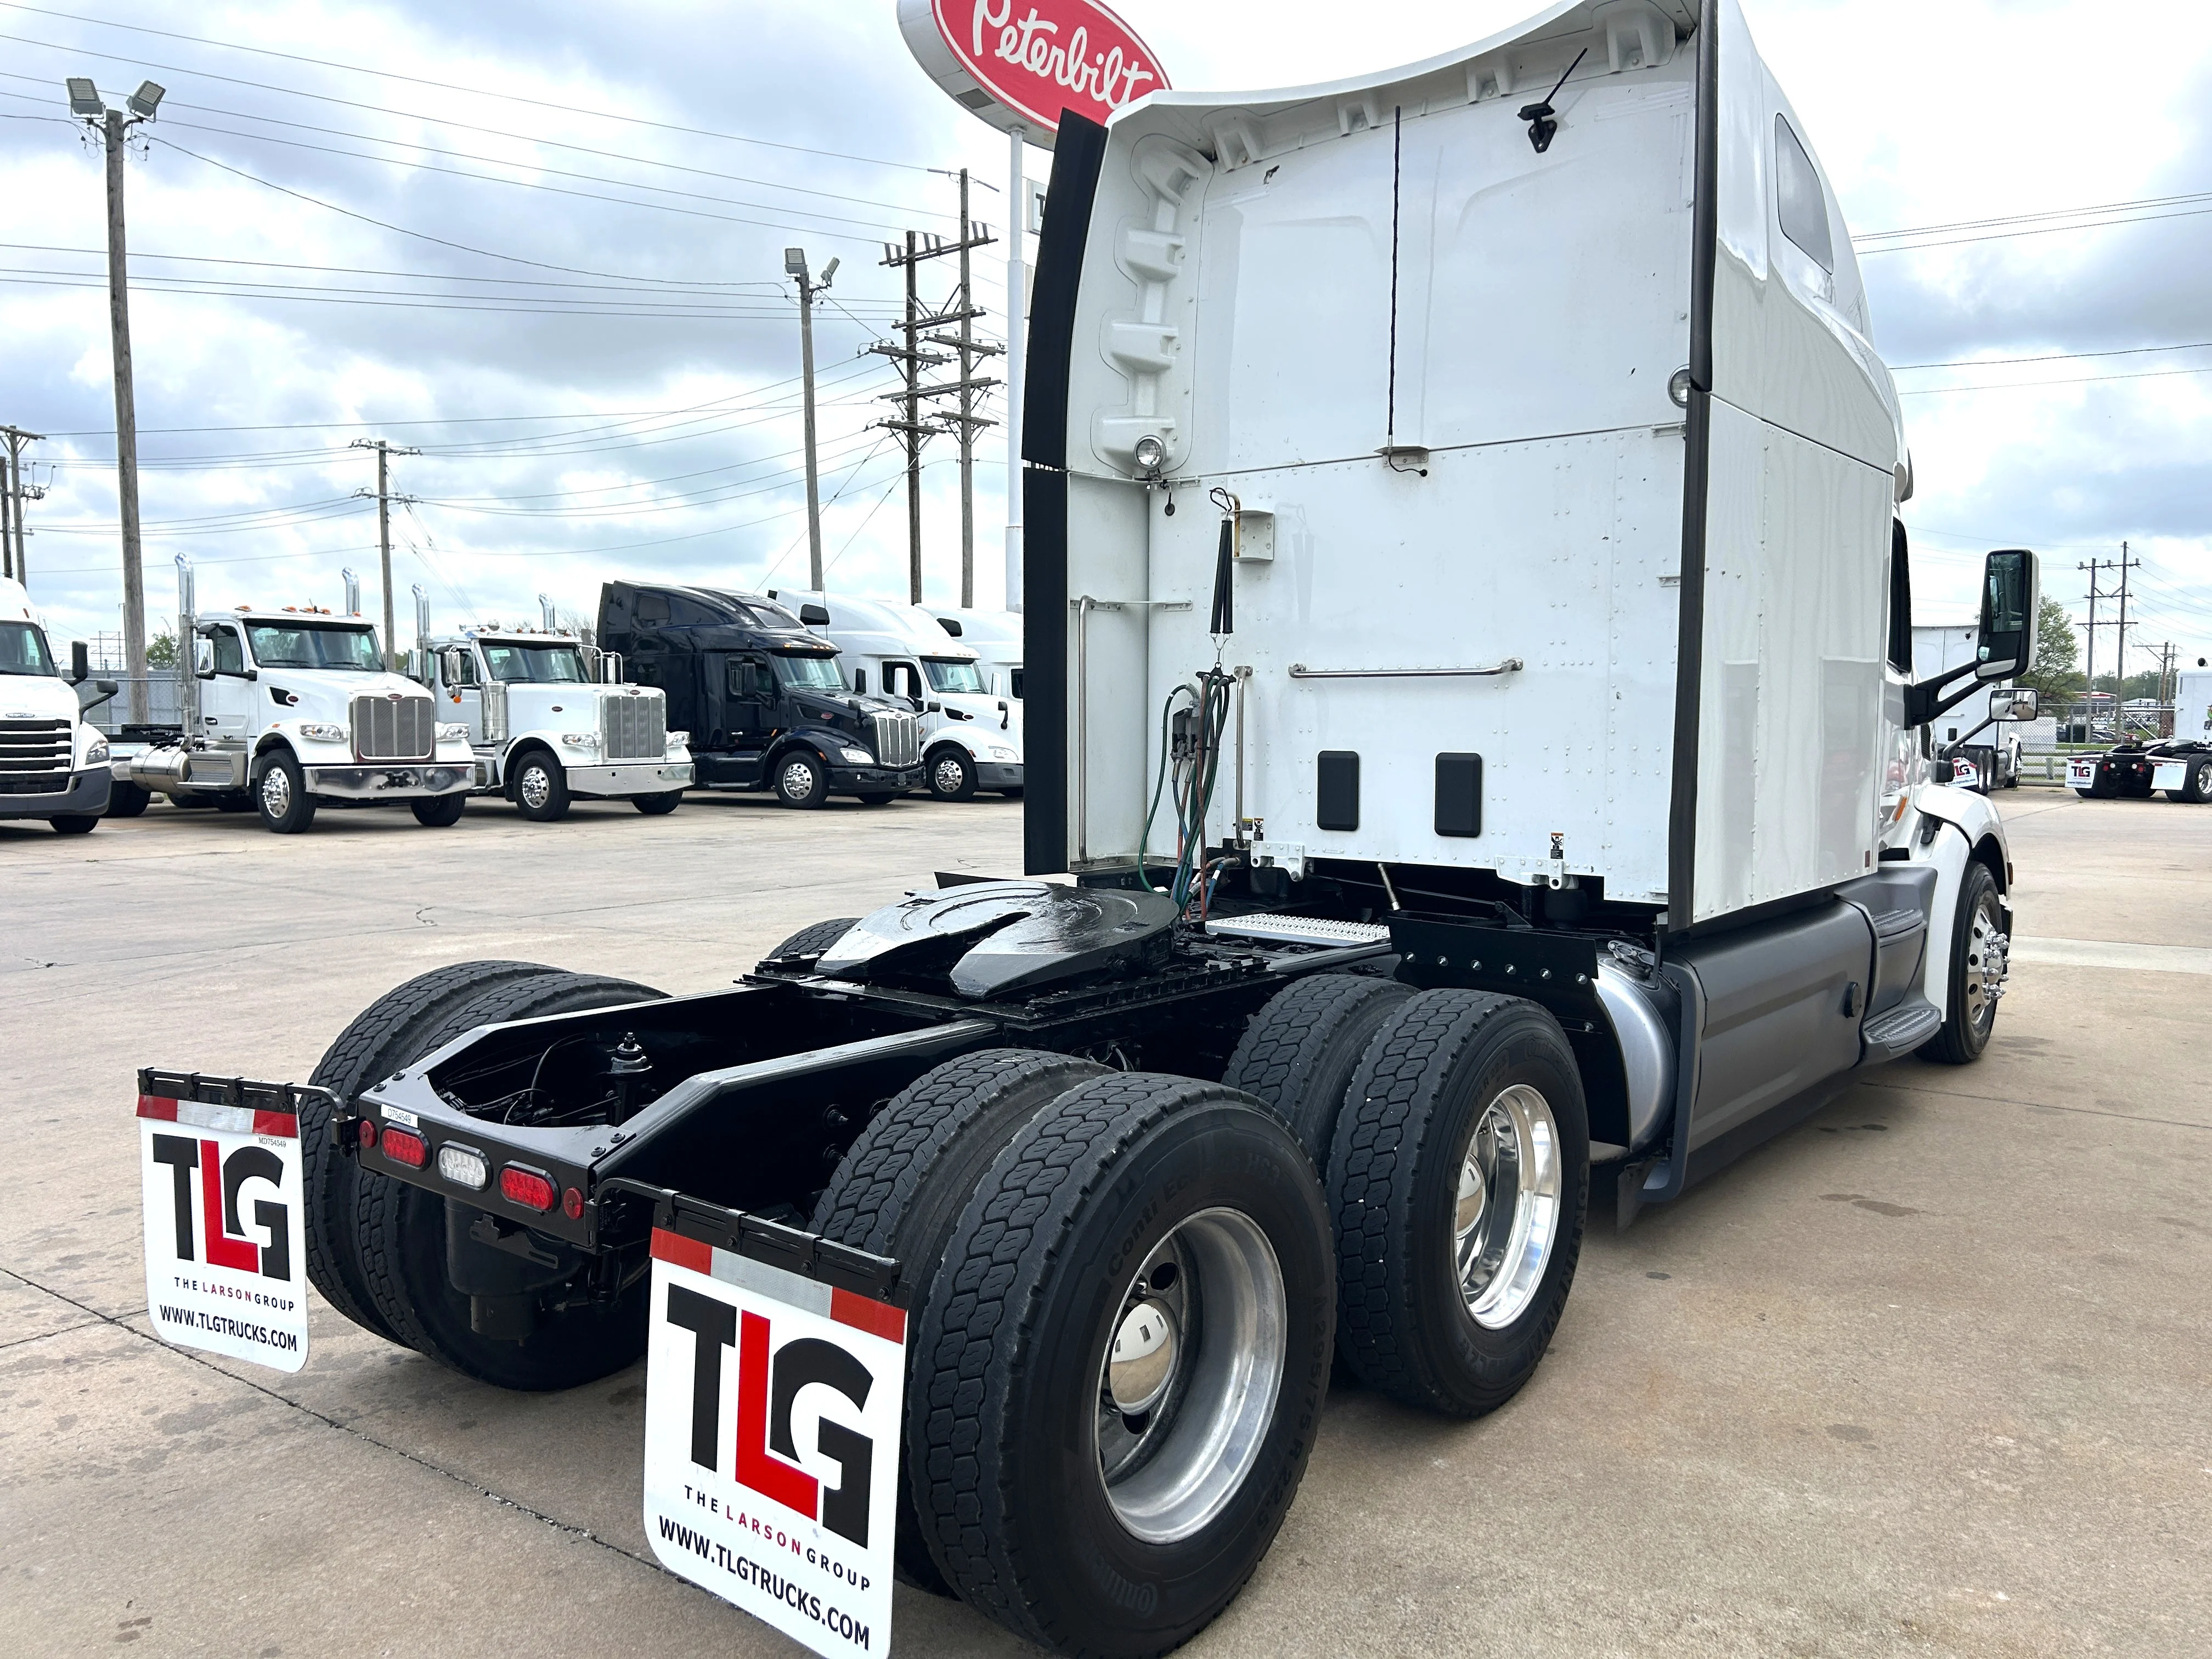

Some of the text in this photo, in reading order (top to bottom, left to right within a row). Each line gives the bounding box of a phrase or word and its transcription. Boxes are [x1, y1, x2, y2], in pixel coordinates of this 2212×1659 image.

[972, 0, 1153, 110] Peterbilt
[1954, 764, 1971, 776] LG
[2071, 766, 2090, 777] TLG
[387, 1108, 411, 1125] D754549
[153, 1133, 291, 1282] TLG
[159, 1304, 297, 1352] WWW.TLGTRUCKS.COM
[174, 1277, 294, 1312] THE LARSON GROUP
[667, 1283, 873, 1550] TLG
[685, 1485, 870, 1592] THE LARSON GROUP
[659, 1515, 870, 1651] WWW.TLGTRUCKS.COM
